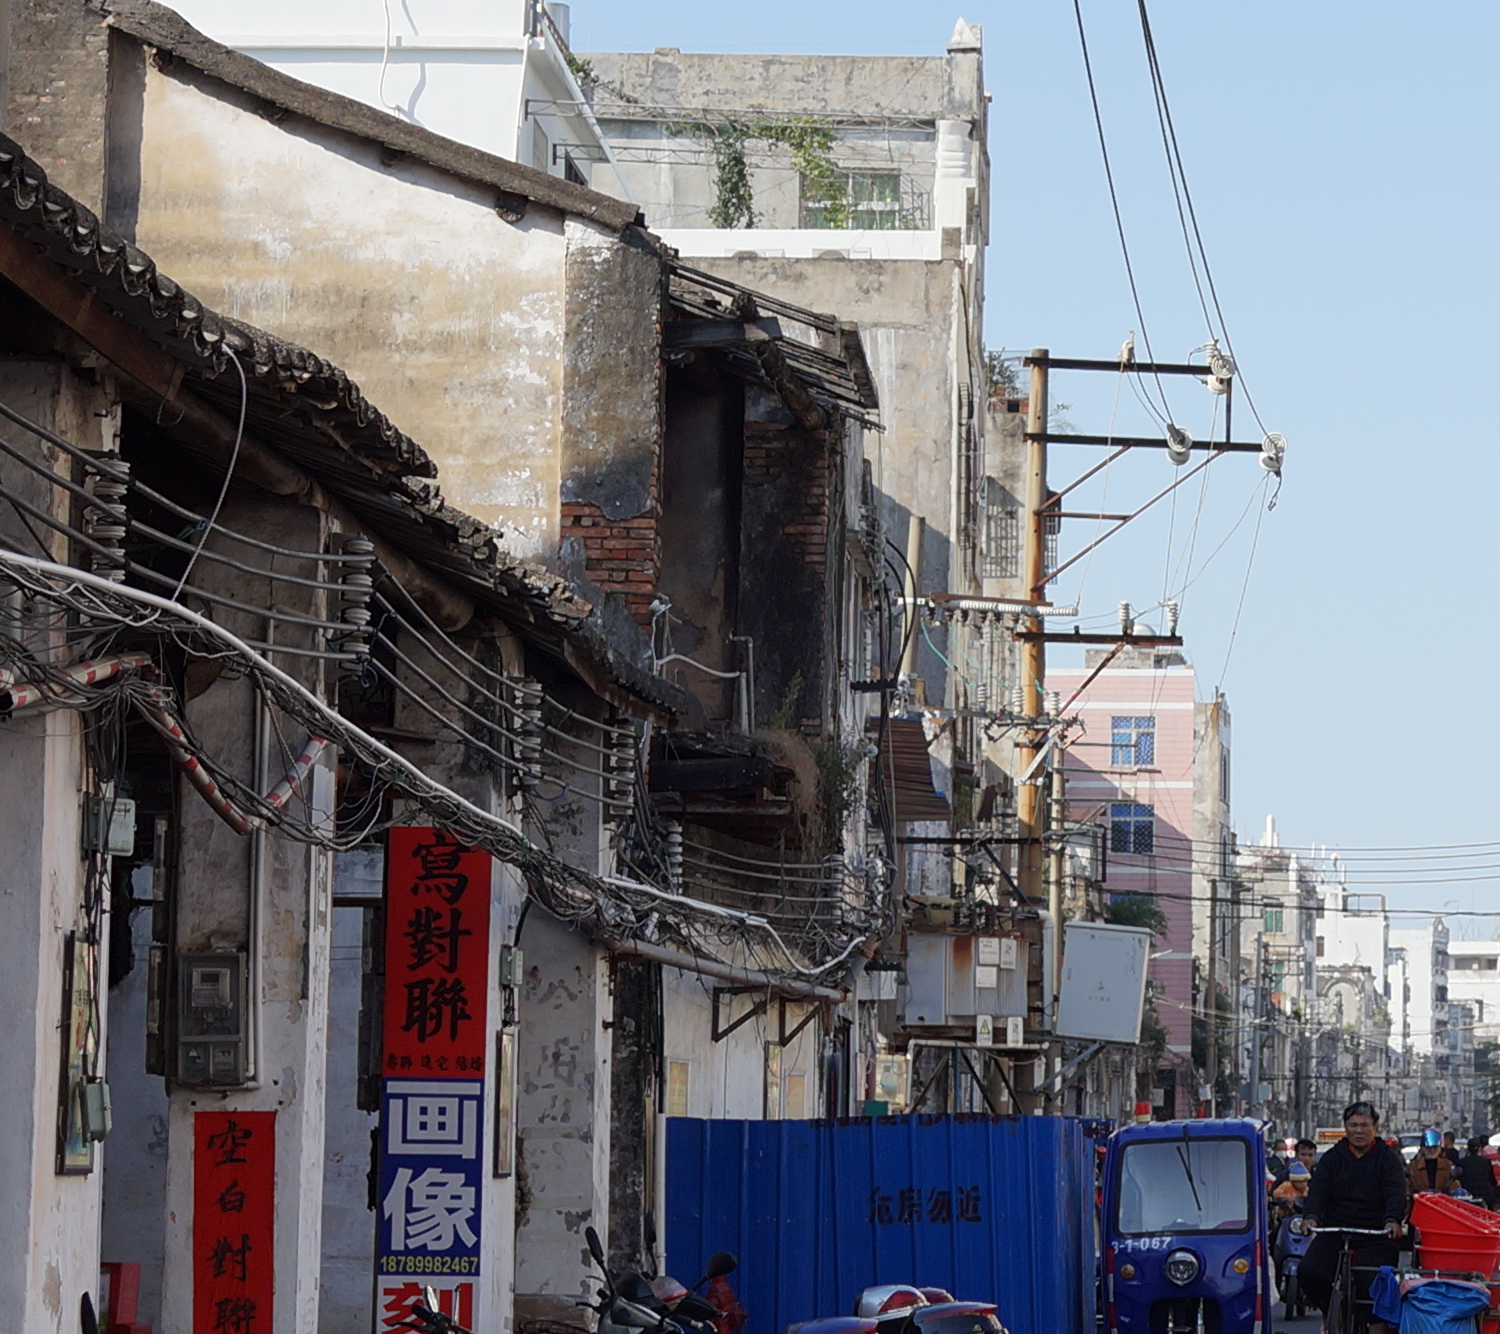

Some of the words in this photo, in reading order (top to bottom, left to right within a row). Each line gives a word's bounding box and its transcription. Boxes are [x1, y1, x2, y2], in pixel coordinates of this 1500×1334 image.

[383, 1081, 481, 1252] 画像
[867, 1184, 984, 1226] 危房勿近
[380, 1255, 479, 1274] 18789982467
